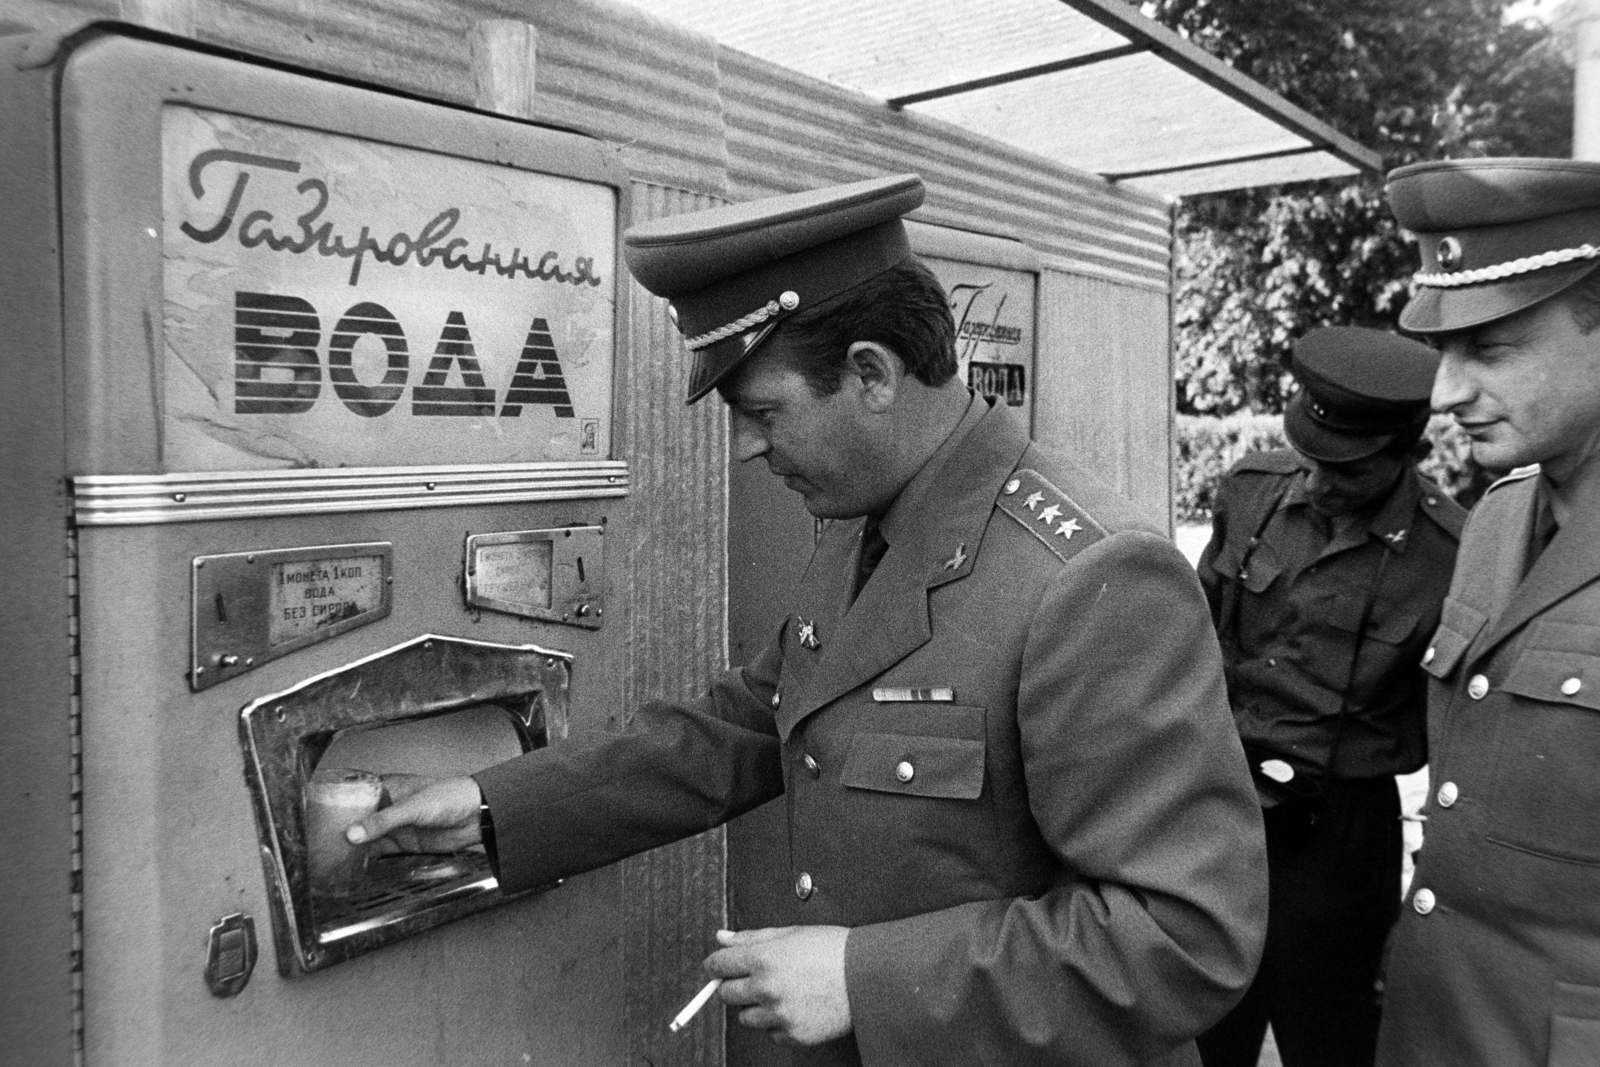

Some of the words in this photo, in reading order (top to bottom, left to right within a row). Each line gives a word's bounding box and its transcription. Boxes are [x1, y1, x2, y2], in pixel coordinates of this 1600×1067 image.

[181, 149, 601, 286] Газированная
[235, 291, 576, 418] ВОДА
[284, 606, 306, 620] БЕЗ
[304, 586, 335, 599] ВОДА
